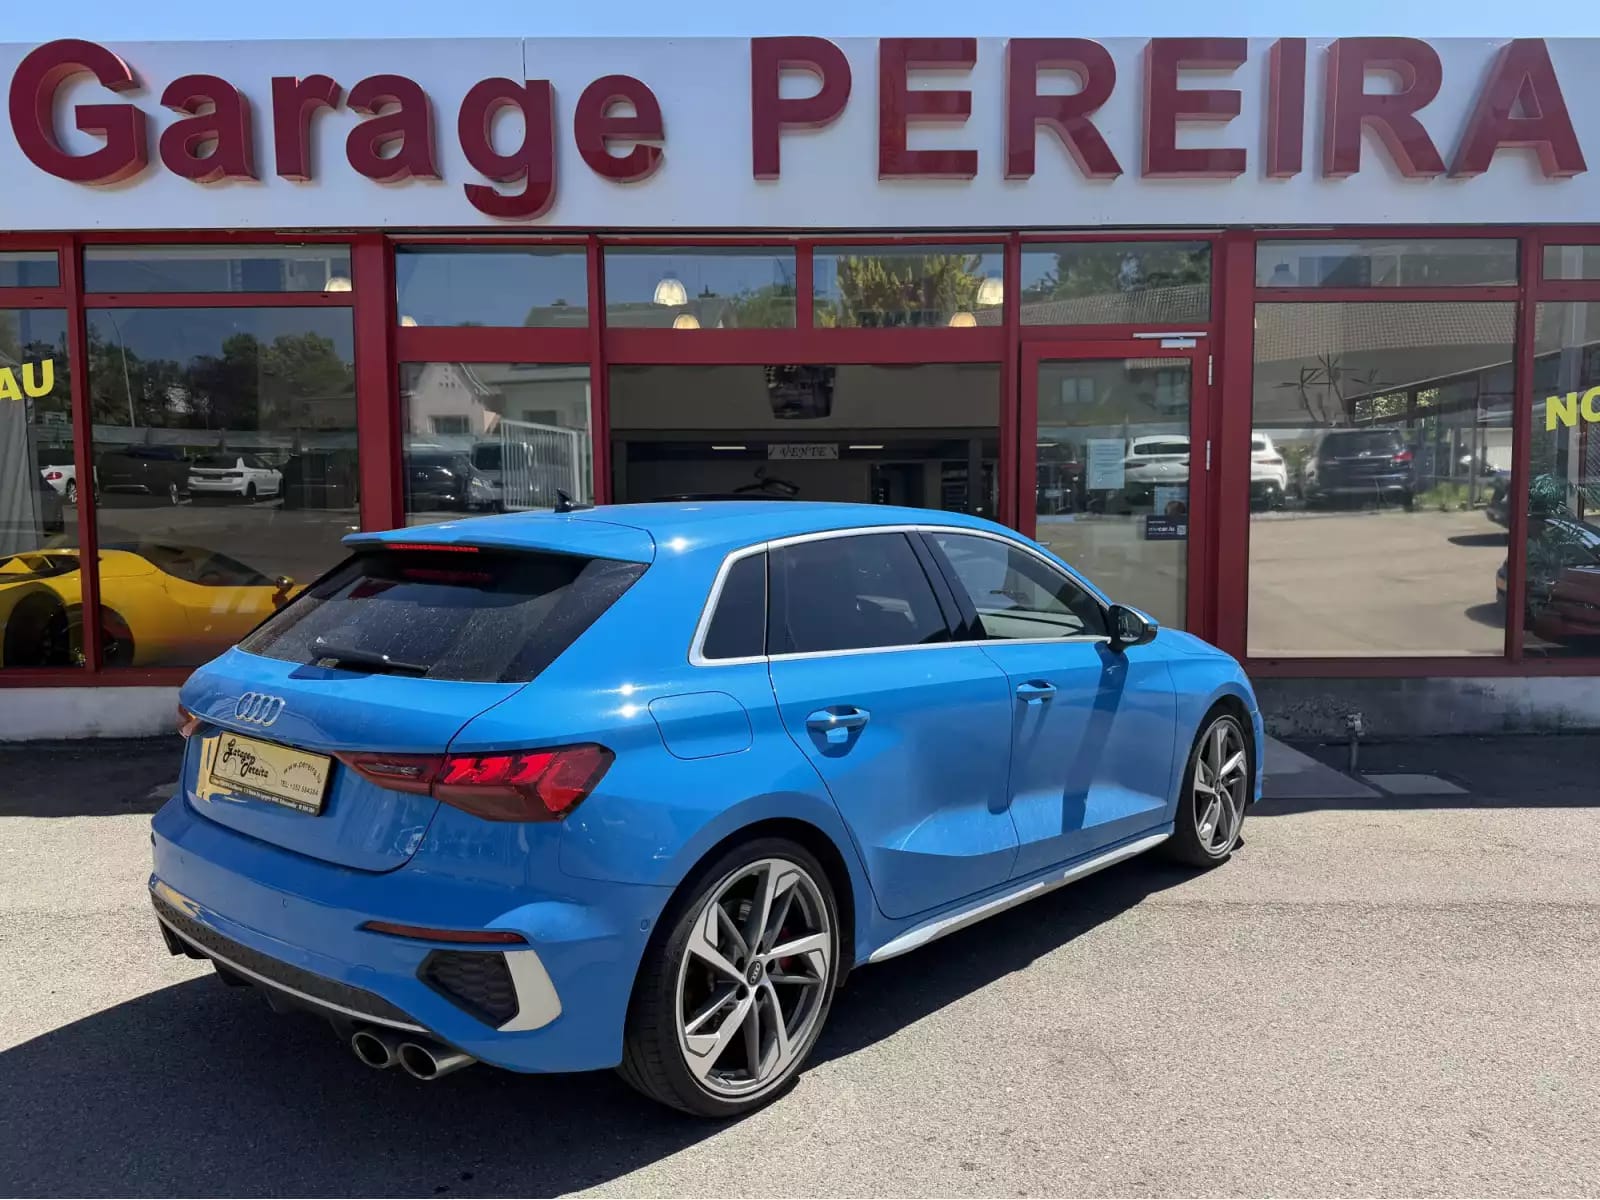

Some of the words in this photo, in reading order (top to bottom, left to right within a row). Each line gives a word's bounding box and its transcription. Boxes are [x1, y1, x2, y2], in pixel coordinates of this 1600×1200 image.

[9, 38, 664, 220] Garage
[750, 37, 1588, 180] PEREIRA
[780, 445, 827, 458] VENTE
